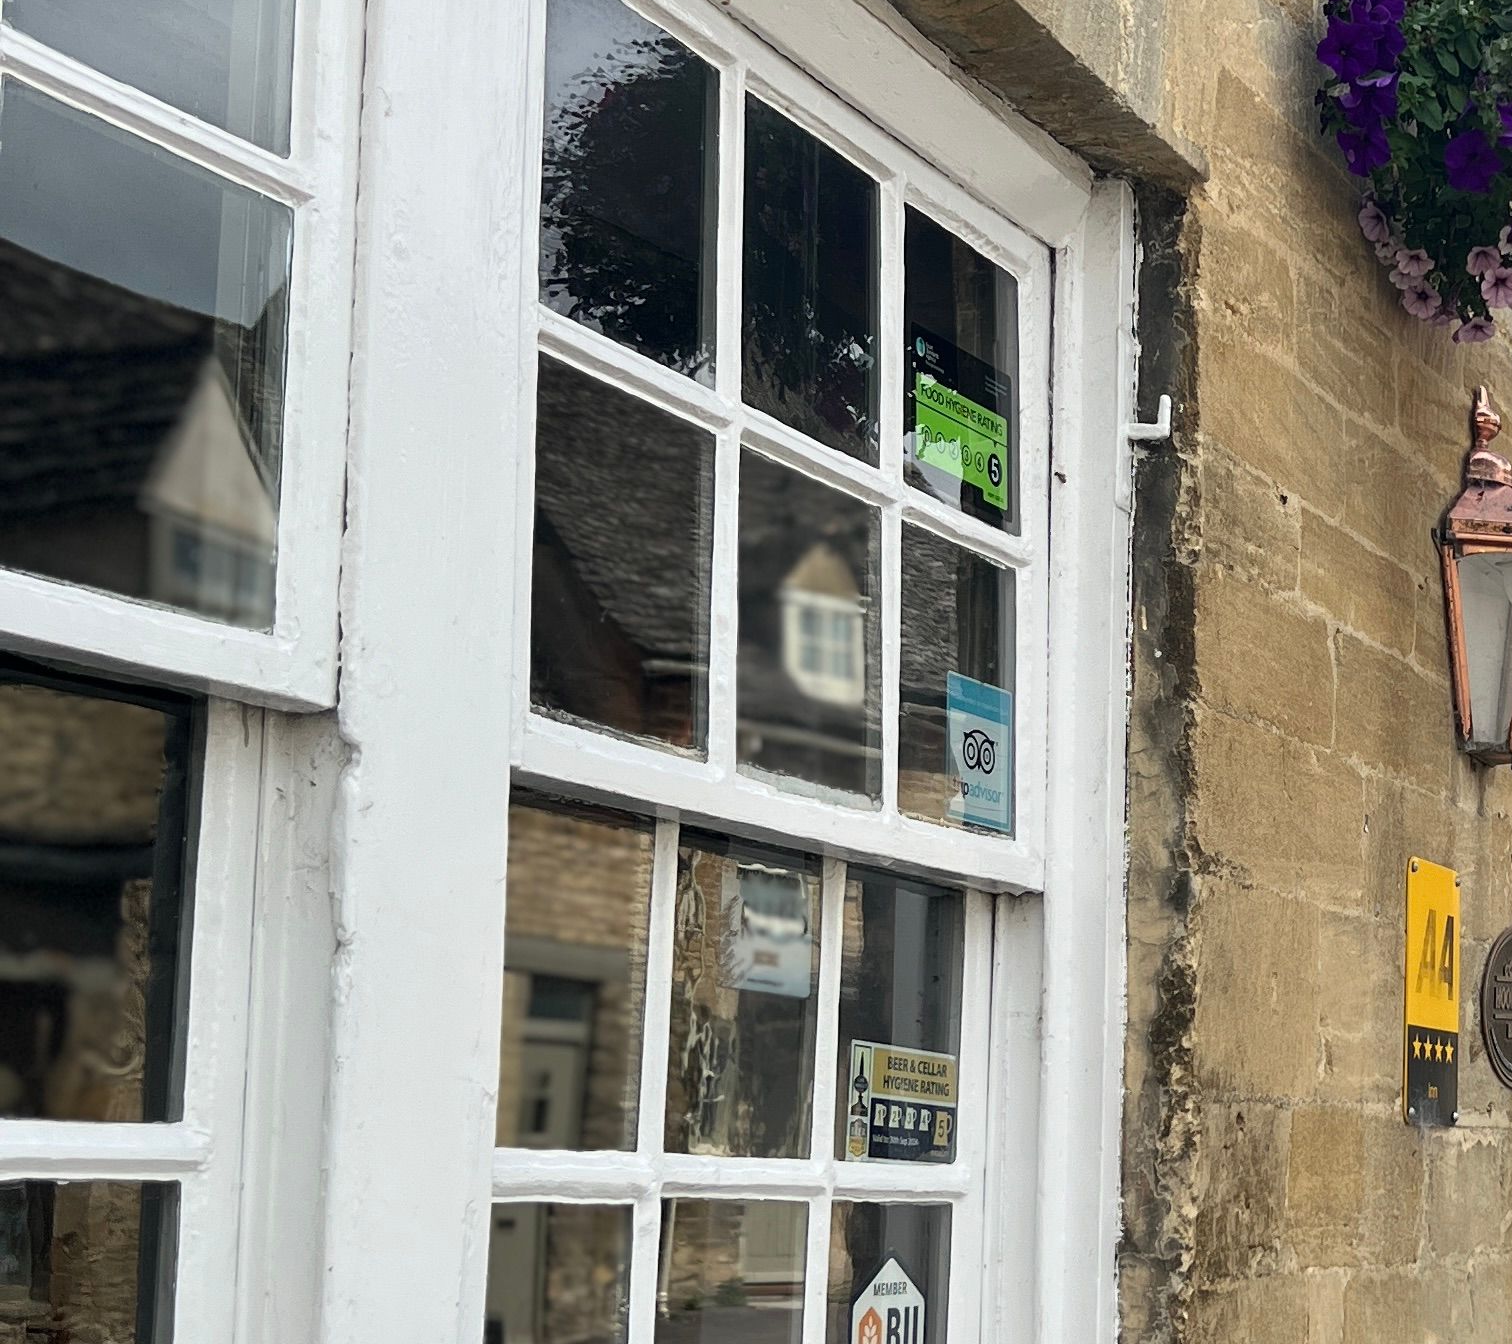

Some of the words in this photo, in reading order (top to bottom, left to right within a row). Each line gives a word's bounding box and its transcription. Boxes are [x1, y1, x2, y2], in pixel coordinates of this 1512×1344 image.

[920, 383, 944, 406] FOOD
[945, 396, 977, 424] HYGIENE
[977, 412, 1003, 437] RATING
[990, 456, 999, 483] 5
[953, 775, 1003, 804] tripadvisor
[1415, 908, 1454, 1001] AA
[887, 1056, 909, 1073] BEER
[909, 1059, 916, 1074] &
[917, 1060, 948, 1078] CELLAR
[882, 1074, 920, 1093] HYGIENE
[920, 1079, 950, 1097] RATING
[938, 1119, 945, 1138] 5
[873, 1281, 908, 1297] MEMBER
